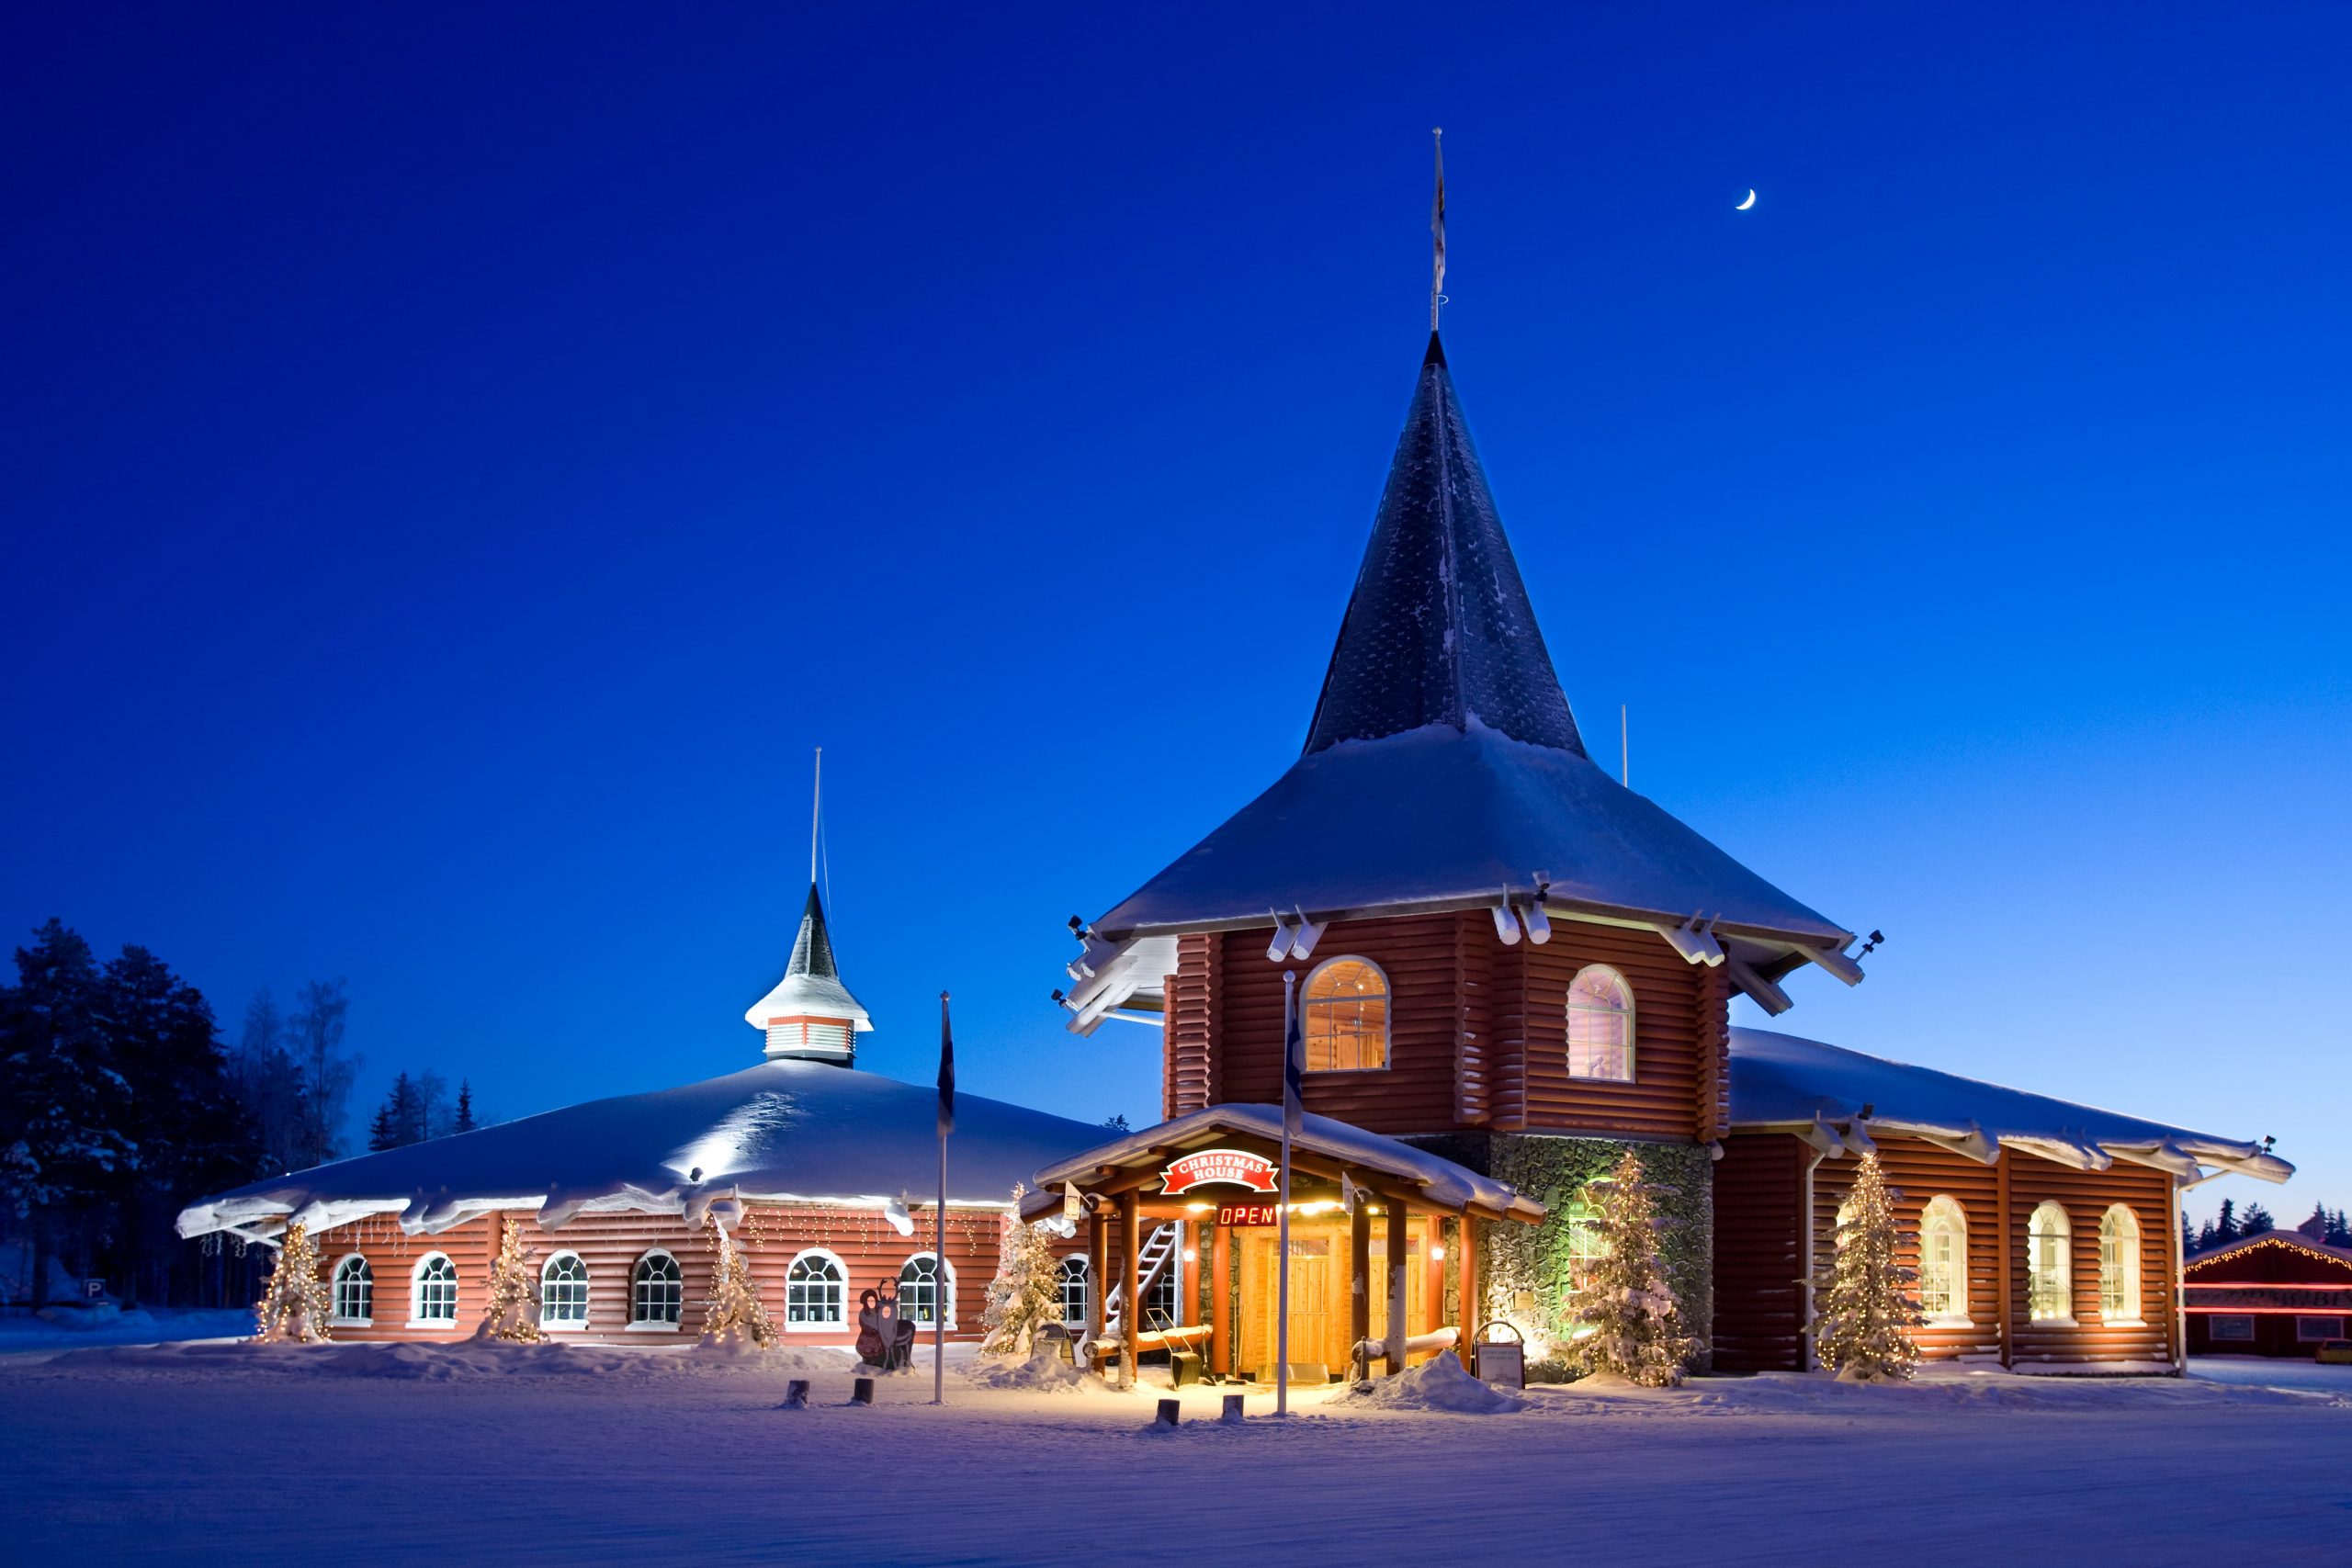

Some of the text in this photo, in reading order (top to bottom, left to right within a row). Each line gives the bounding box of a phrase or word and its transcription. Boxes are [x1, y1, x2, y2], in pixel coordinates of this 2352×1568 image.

[1179, 1156, 1263, 1174] CHRISTMAS
[1193, 1167, 1244, 1180] HOUSE
[1220, 1208, 1273, 1224] OPEN
[88, 1282, 102, 1297] P
